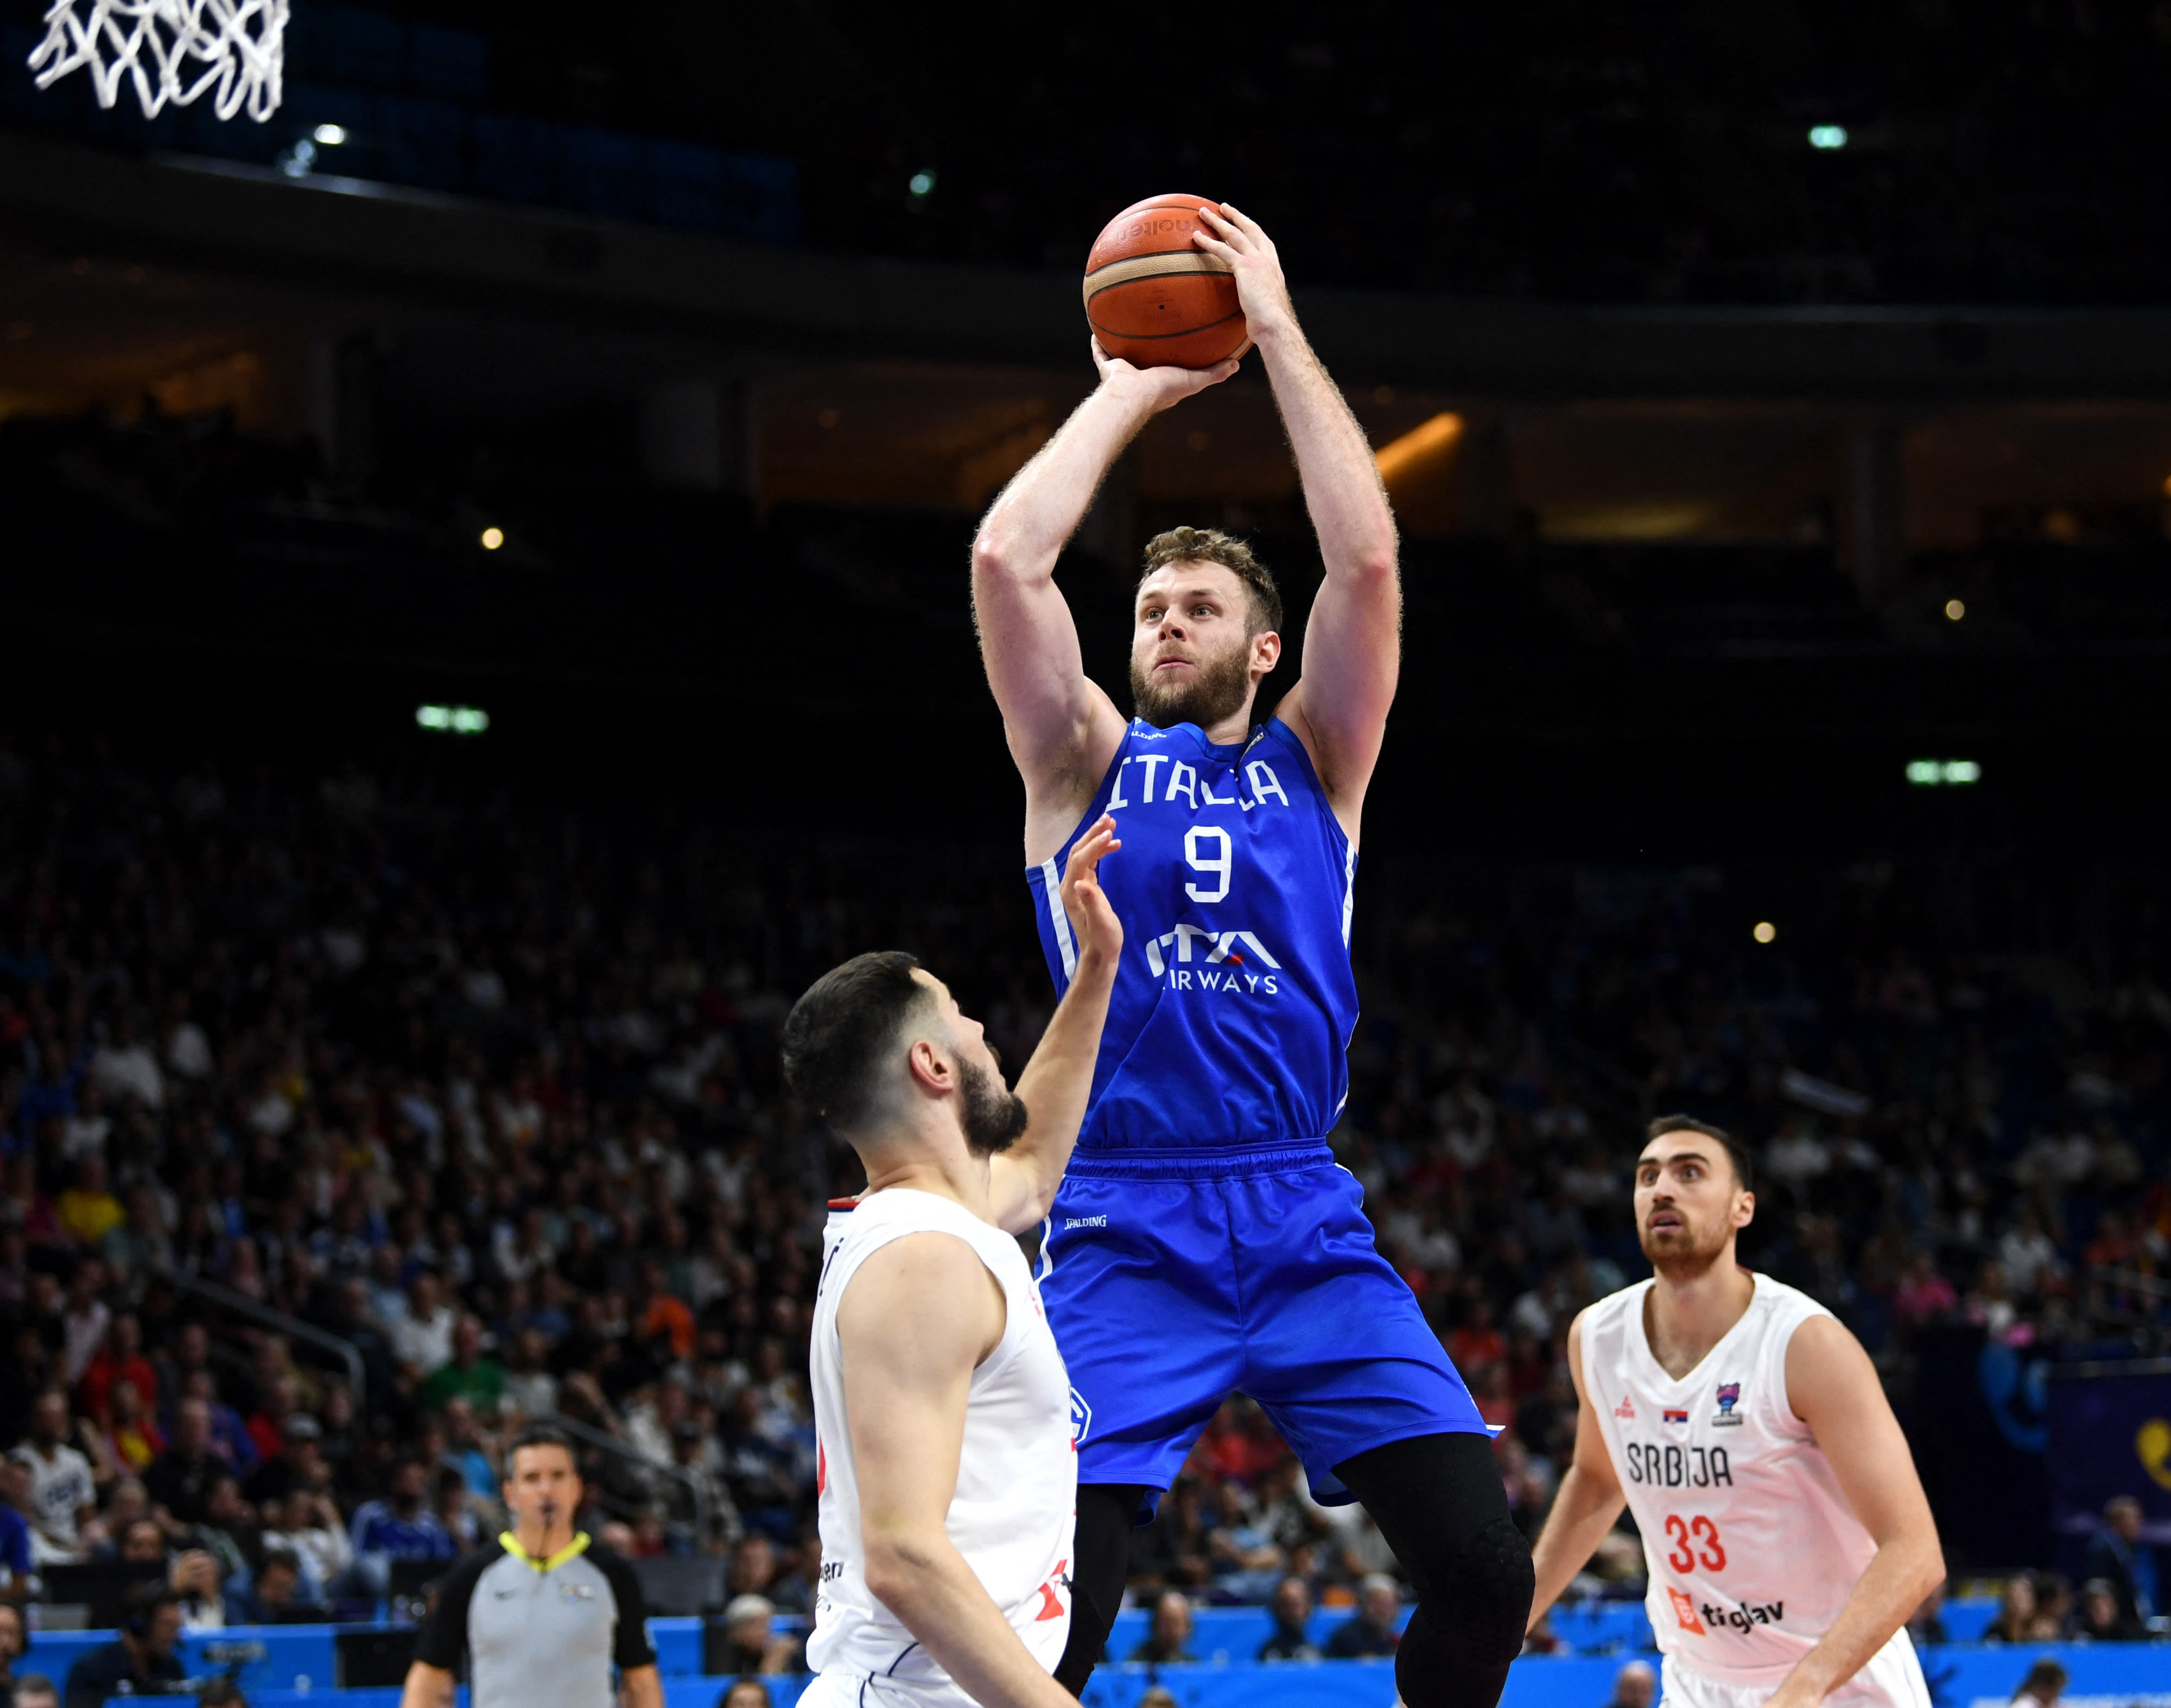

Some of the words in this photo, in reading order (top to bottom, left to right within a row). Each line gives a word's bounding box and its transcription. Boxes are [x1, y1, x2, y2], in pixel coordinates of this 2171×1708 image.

[1184, 826, 1231, 903] 9
[1162, 969, 1278, 995] IRWAYS
[1064, 1214, 1107, 1230] SPALDING
[1627, 1443, 1732, 1488] SRBIJA
[1665, 1514, 1727, 1574] 33
